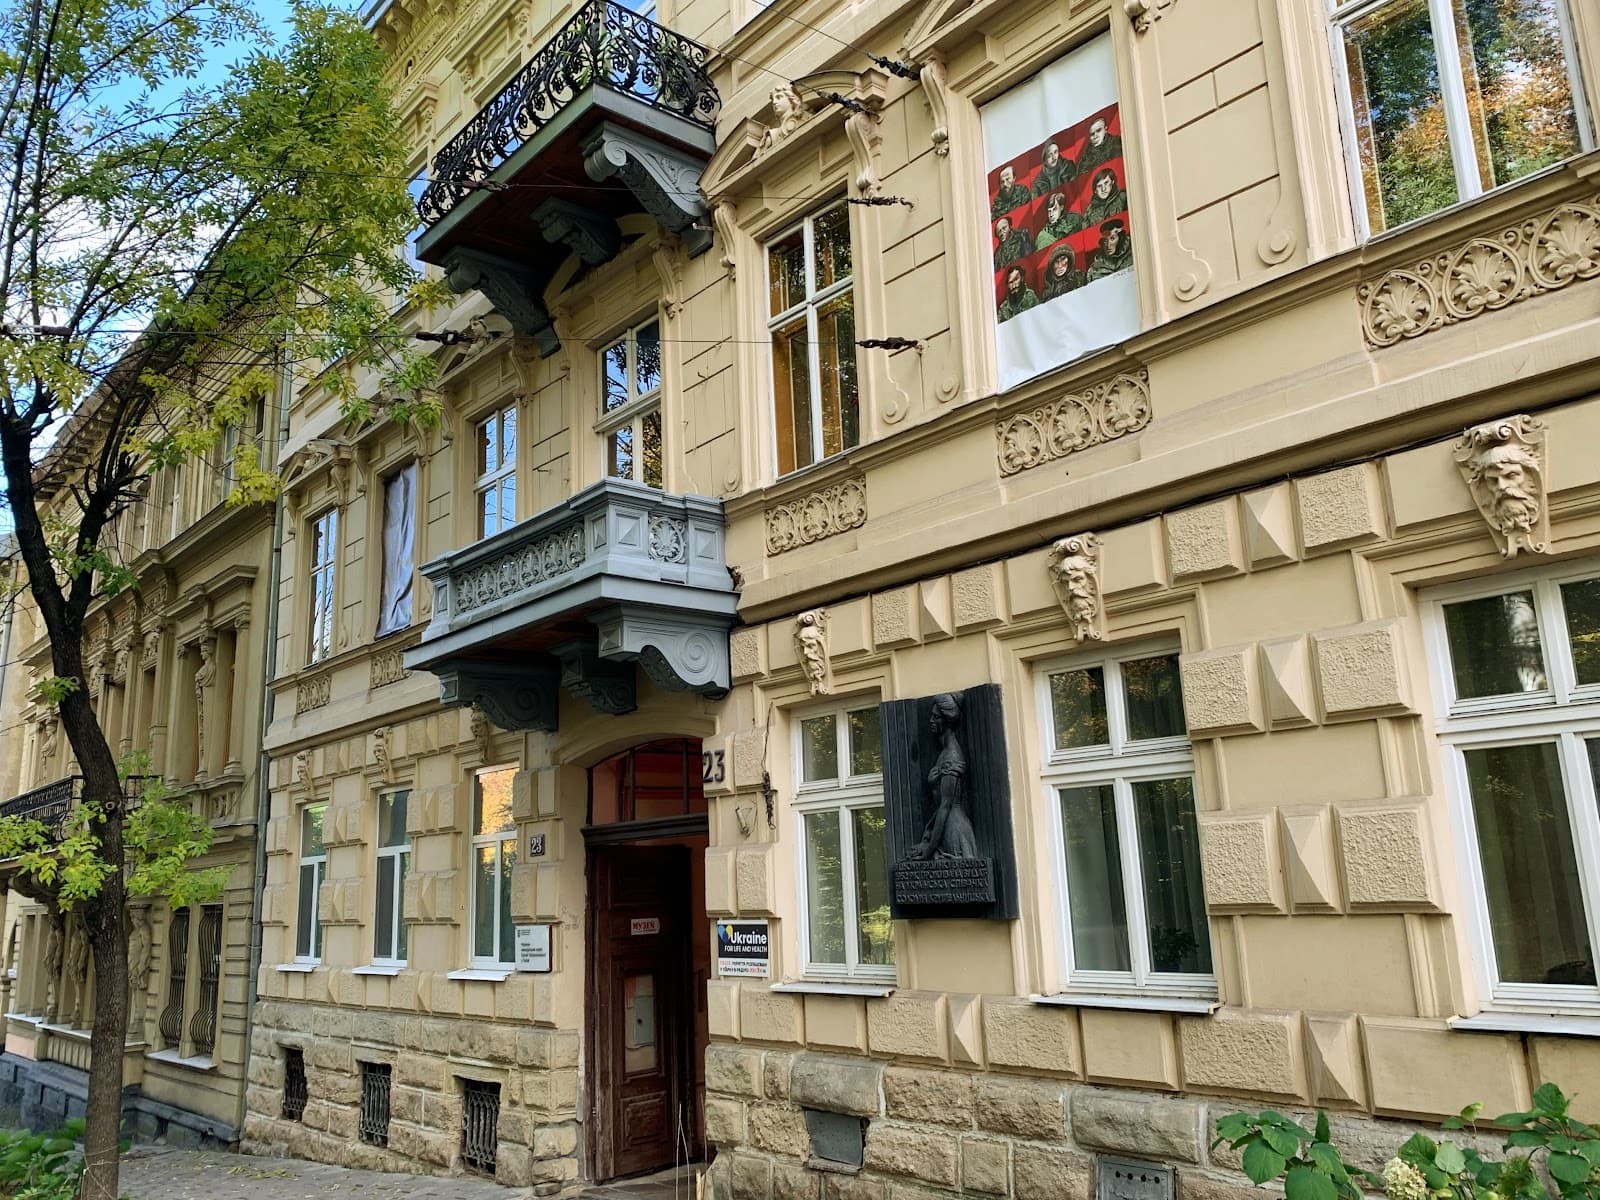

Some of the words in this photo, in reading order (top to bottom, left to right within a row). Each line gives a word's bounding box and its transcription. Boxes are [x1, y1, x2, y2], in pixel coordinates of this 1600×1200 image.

[702, 750, 725, 783] 23
[531, 837, 542, 854] 23
[730, 930, 767, 944] Ukraine
